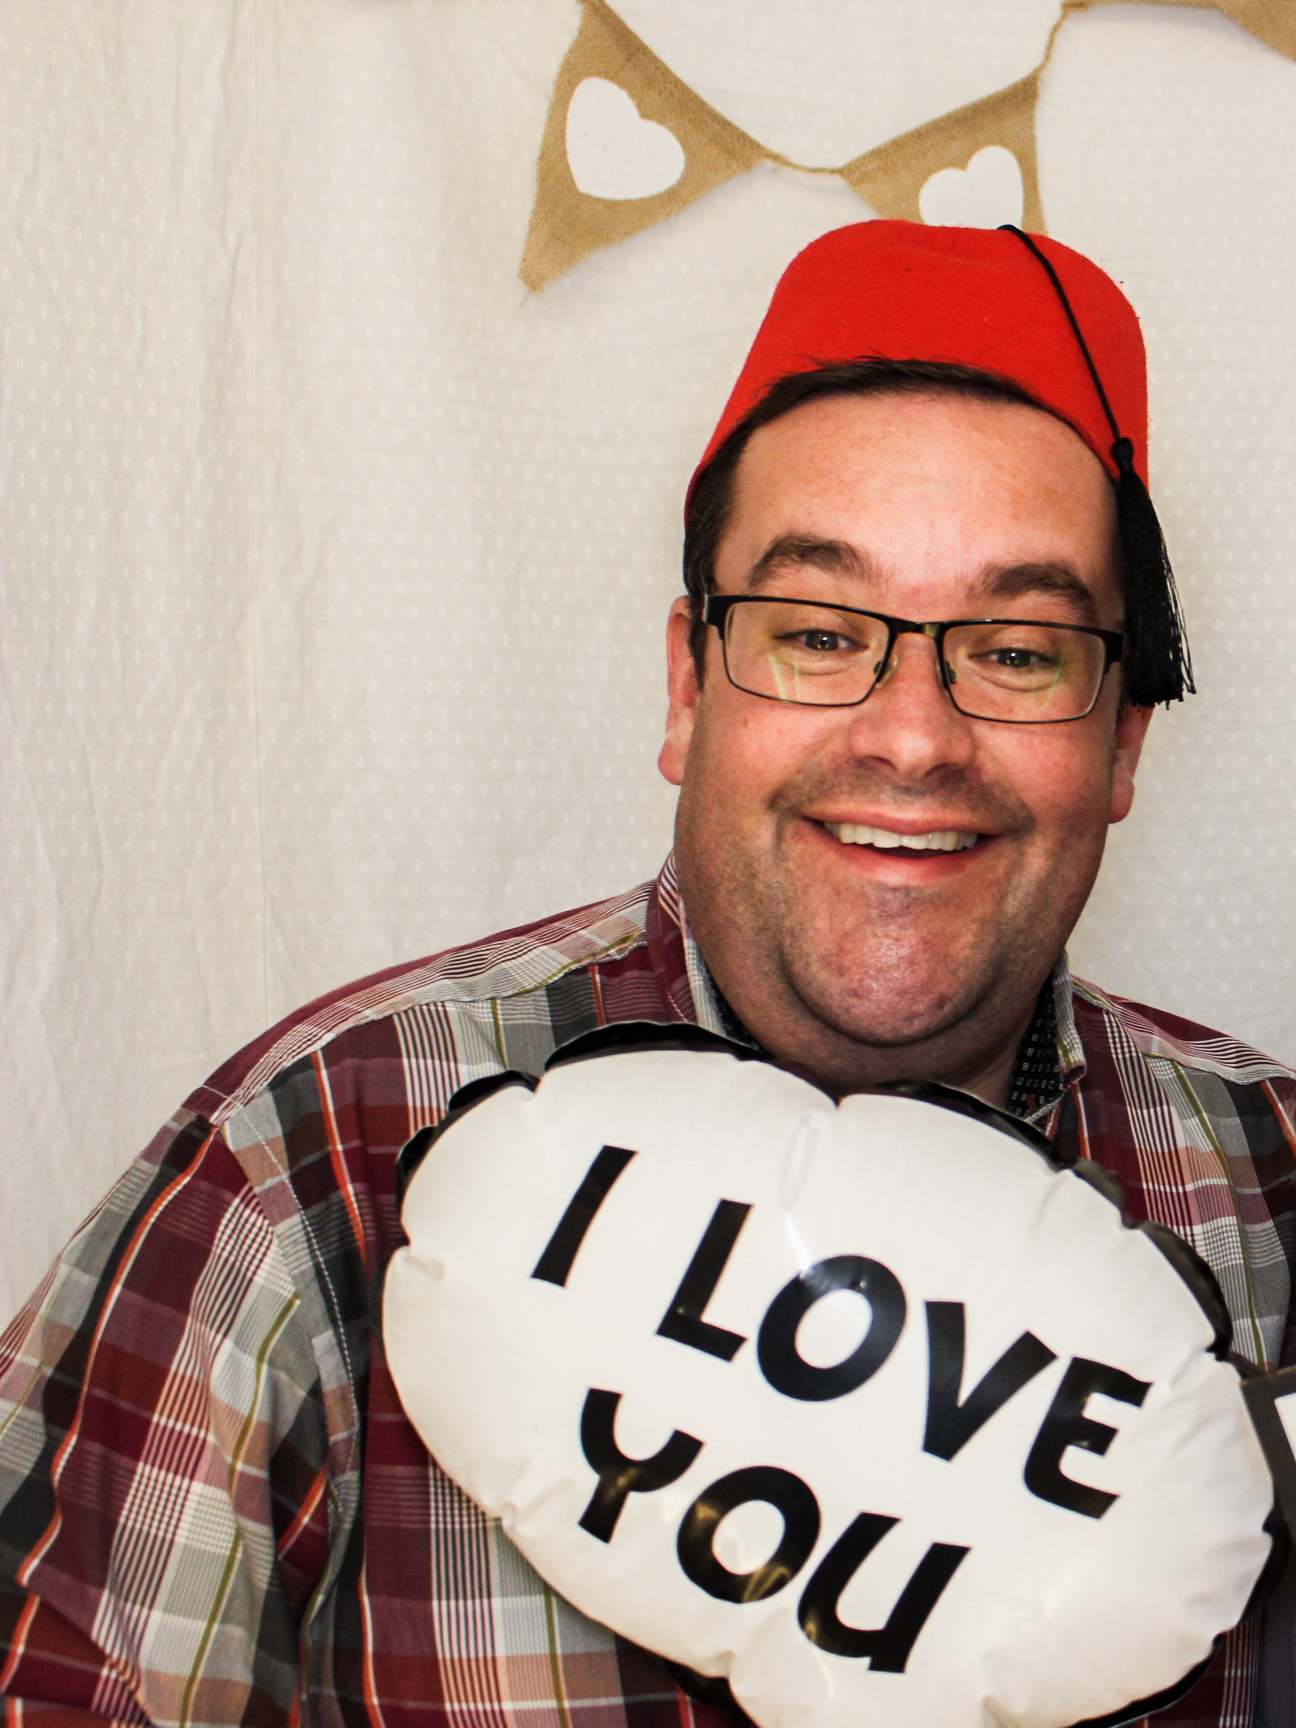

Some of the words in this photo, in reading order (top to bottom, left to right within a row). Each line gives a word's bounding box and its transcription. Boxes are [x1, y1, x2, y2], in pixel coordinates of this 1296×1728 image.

[531, 1145, 638, 1288] I
[655, 1198, 1154, 1520] LOVE
[578, 1387, 971, 1674] YOU
